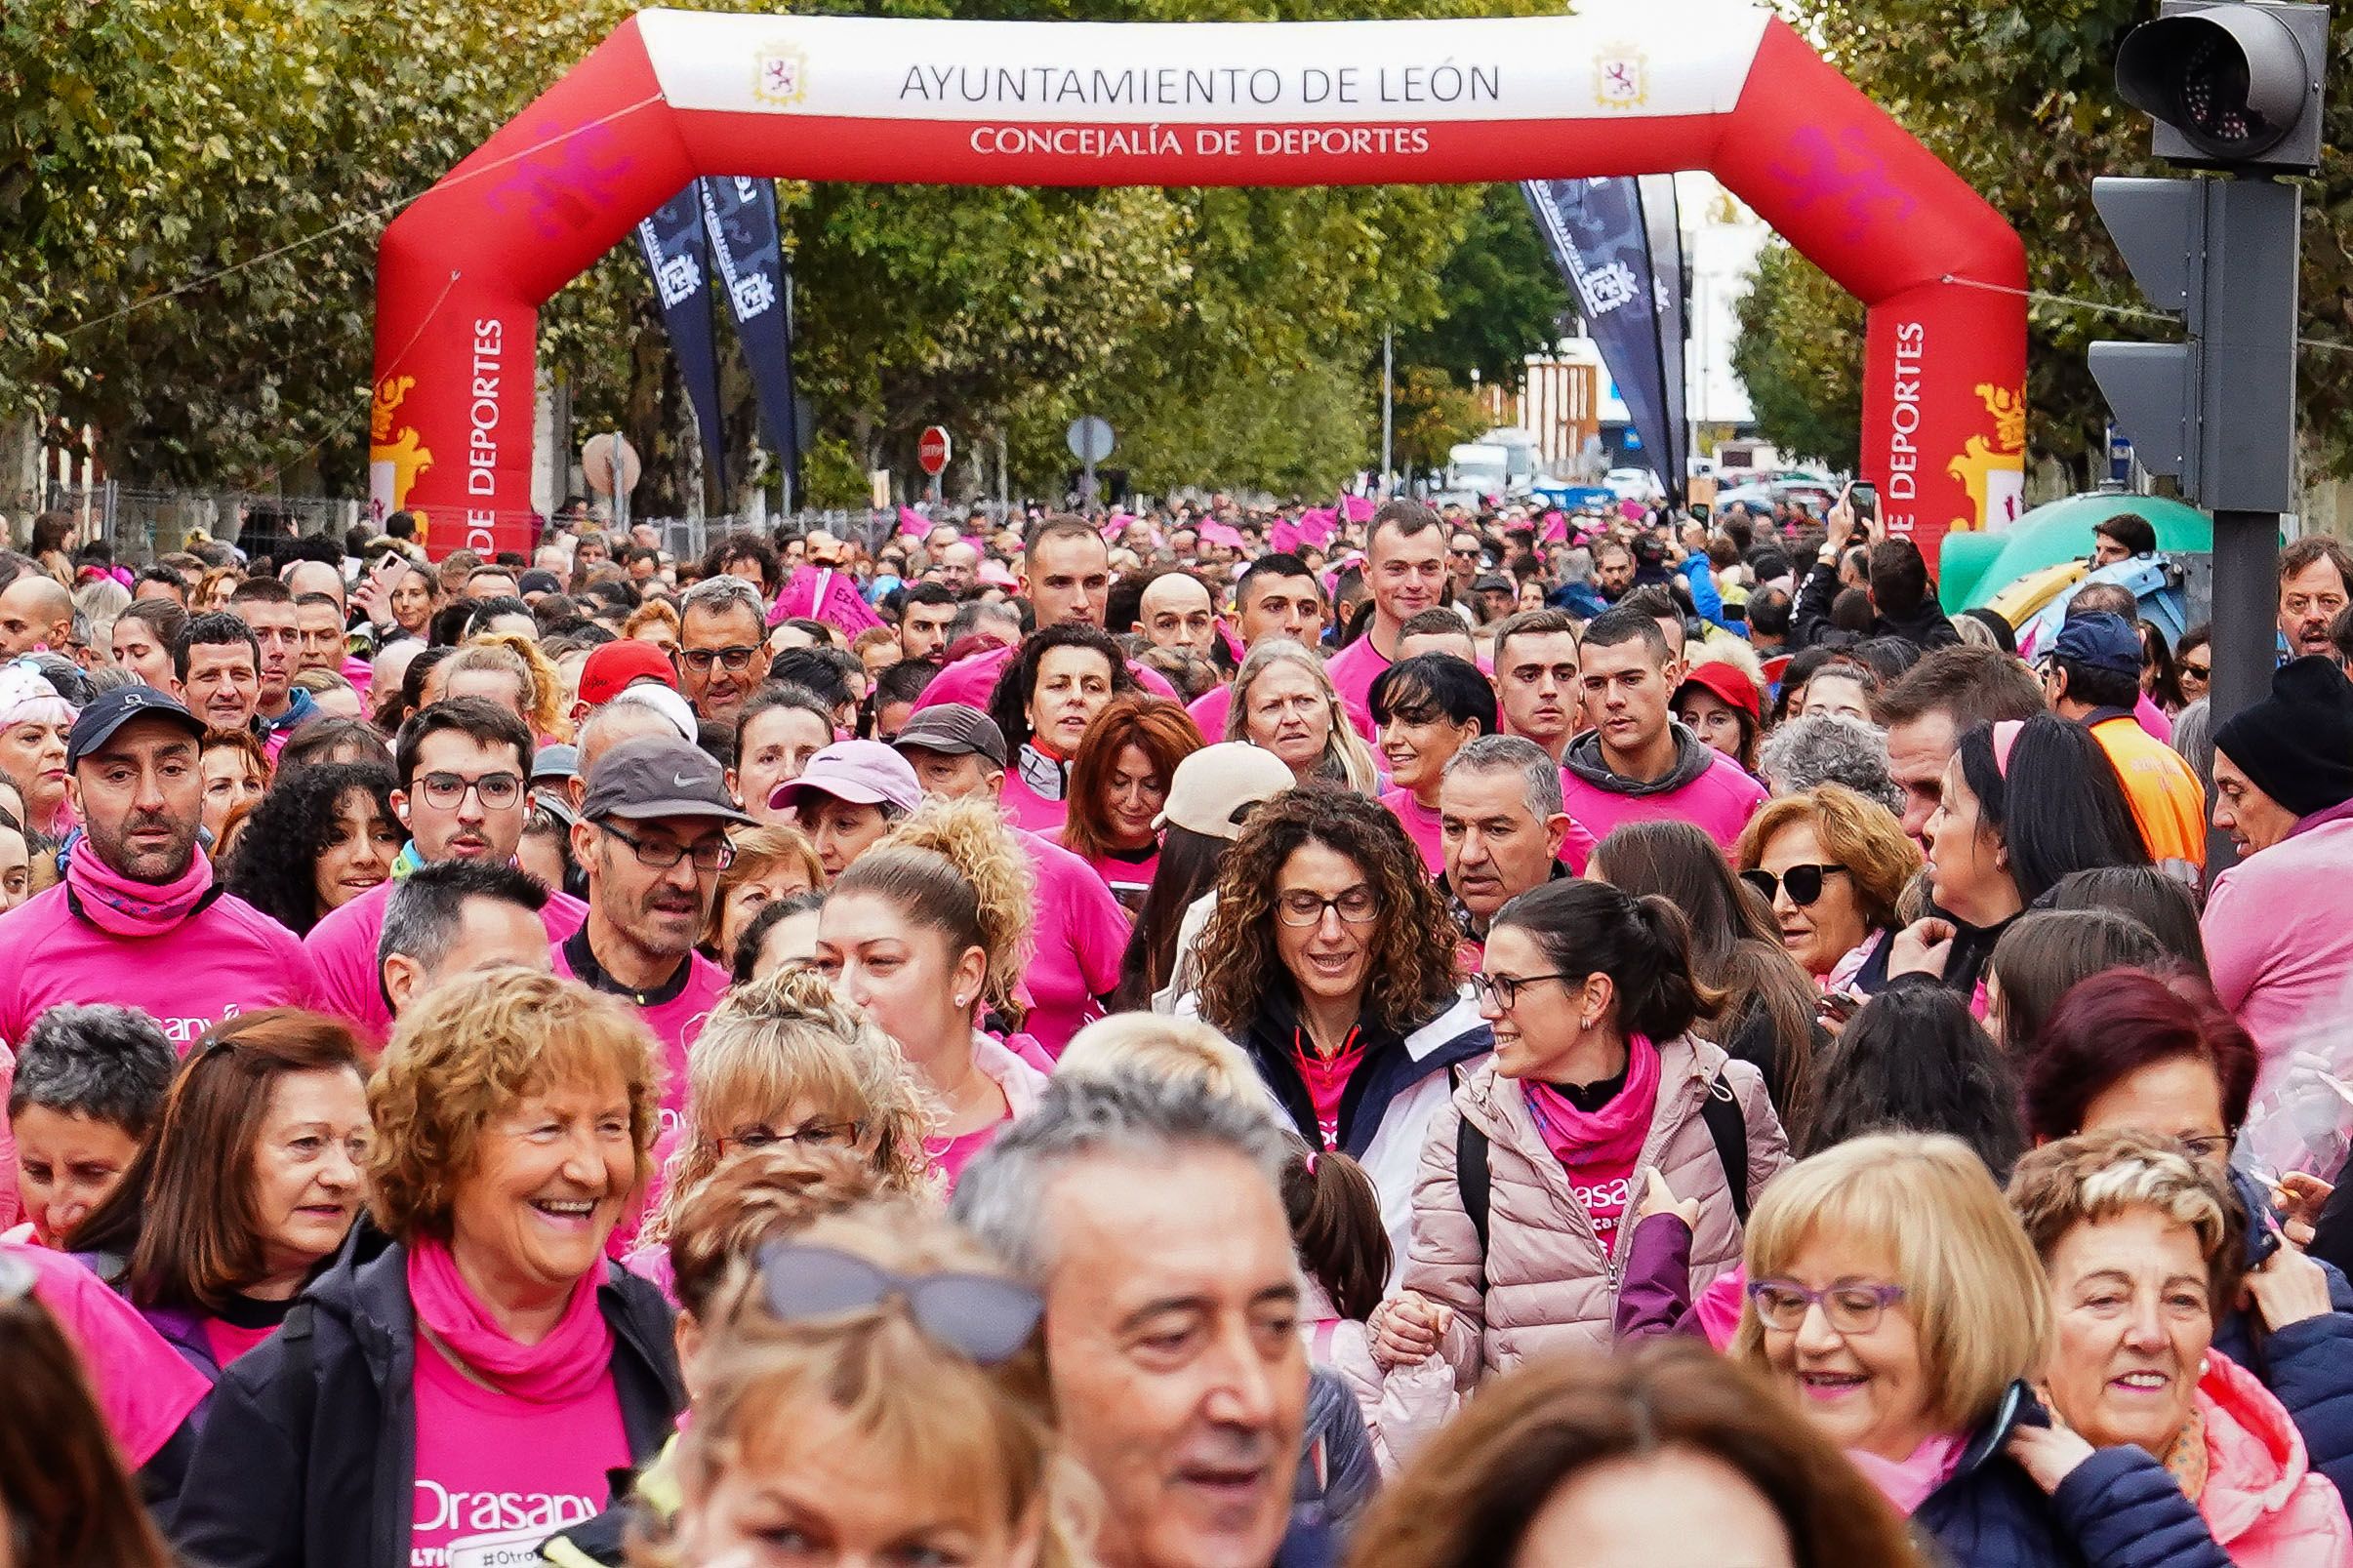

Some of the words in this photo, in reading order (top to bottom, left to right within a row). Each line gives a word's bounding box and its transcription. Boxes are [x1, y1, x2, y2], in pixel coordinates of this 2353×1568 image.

[899, 64, 1282, 104] AYUNTAMIENTO
[1302, 66, 1359, 104] DE
[1379, 57, 1500, 103] LEÓN
[970, 123, 1183, 157] CONCEJALÍA
[1196, 130, 1240, 156] DE
[1255, 127, 1430, 157] DEPORTES
[467, 319, 503, 496] DEPORTES
[1888, 322, 1925, 500] DEPORTES
[467, 508, 496, 557] DE
